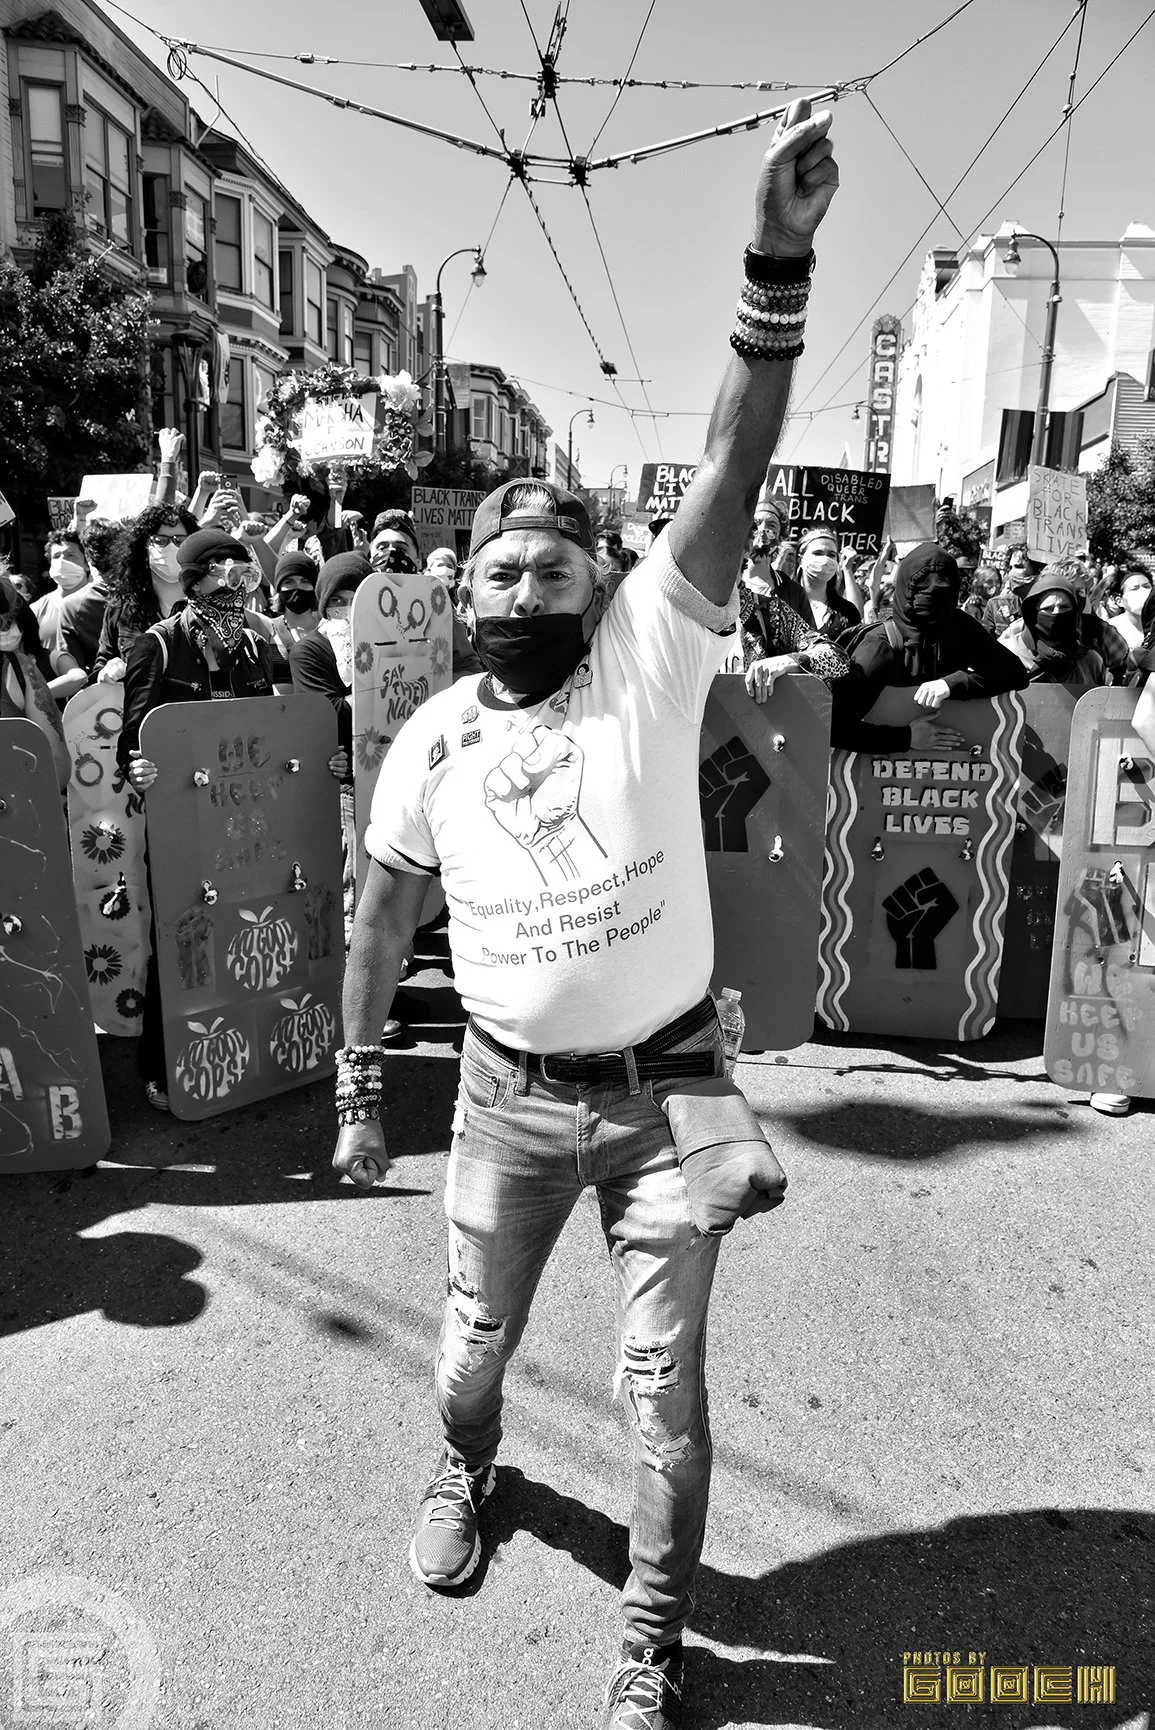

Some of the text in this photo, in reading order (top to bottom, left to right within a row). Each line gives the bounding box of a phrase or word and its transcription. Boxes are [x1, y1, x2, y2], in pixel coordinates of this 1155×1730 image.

[656, 465, 698, 483] BLAC
[772, 468, 814, 497] ALL
[820, 473, 883, 490] DISABLED
[1034, 468, 1081, 496] SKATE
[414, 487, 486, 507] BLACK TRANS
[827, 484, 866, 497] QUEER
[833, 493, 869, 505] TRANS
[413, 506, 475, 527] LIVES MATT
[788, 498, 856, 524] BLACK
[1033, 498, 1084, 523] BLACK
[1035, 517, 1084, 540] TRANS
[838, 531, 879, 553] TTER
[873, 760, 992, 781] DEFEND
[882, 786, 979, 809] BLACK
[885, 813, 970, 836] LIVES
[515, 900, 621, 939] And Resist
[481, 899, 666, 966] Power To The People"
[1053, 1060, 1136, 1089] SAFE
[49, 1085, 83, 1140] B
